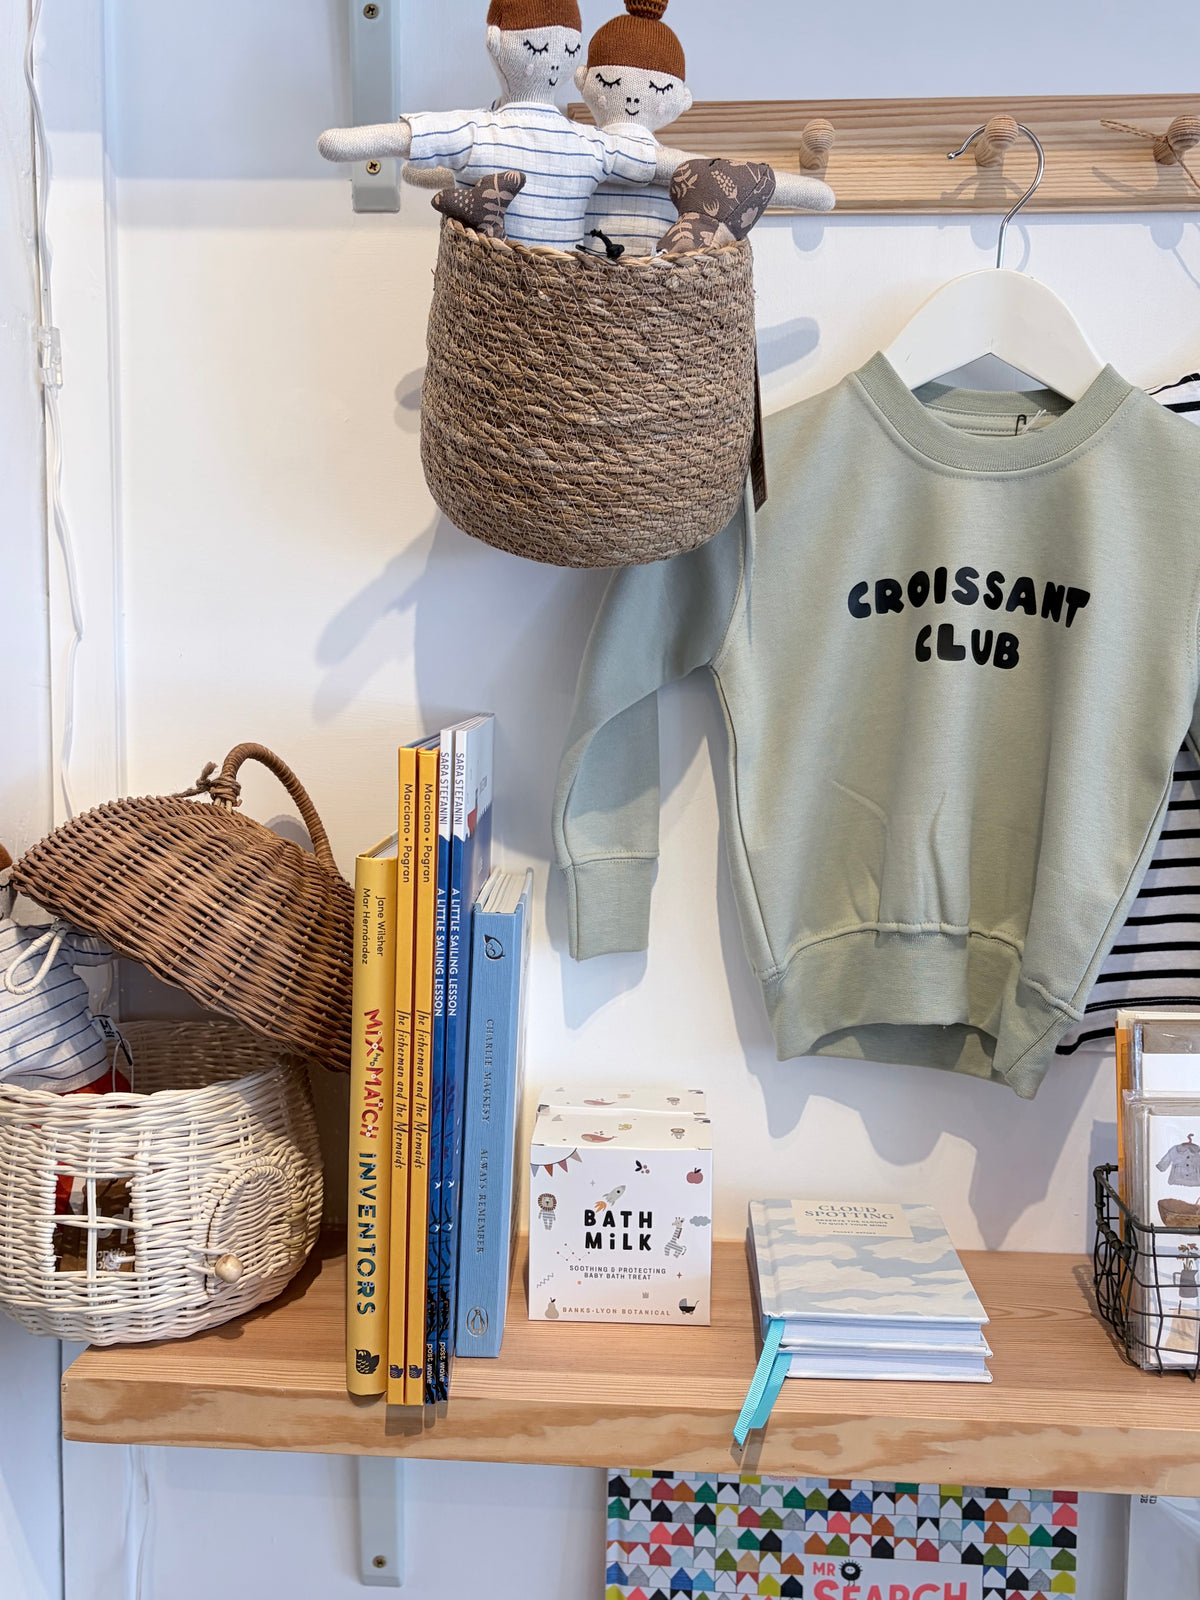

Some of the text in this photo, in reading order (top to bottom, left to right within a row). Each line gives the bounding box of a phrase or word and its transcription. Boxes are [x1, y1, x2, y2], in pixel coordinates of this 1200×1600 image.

[848, 566, 1091, 628] CROISSANT
[915, 623, 1020, 670] CLUB
[439, 752, 450, 825] SARA STEFANINI
[454, 752, 465, 825] SARA STEFANINI
[400, 783, 413, 883] Marciano Pogran
[421, 783, 433, 883] Marciano Pogran
[361, 888, 371, 965] Mar Hernández
[375, 896, 386, 956] Jane Wilsher
[434, 887, 446, 1016] A LITTLE SAILING LESSON
[448, 887, 460, 1016] A LITTLE SAILING LESSON
[396, 1009, 410, 1026] The
[416, 1009, 430, 1026] The
[359, 1067, 384, 1139] MATCH
[395, 1081, 408, 1100] and
[396, 1102, 407, 1118] the
[415, 1081, 428, 1100] and
[415, 1102, 427, 1118] the
[394, 1120, 408, 1169] Mermaids
[413, 1120, 428, 1169] Mermaids
[476, 1018, 494, 1254] CHARLIE MACKESY ALWAYS REMEMBER
[584, 1209, 653, 1229] BATH
[804, 1210, 895, 1220] SPOTTING
[818, 1205, 878, 1213] CLOUD
[569, 1265, 608, 1273] SOOTHING
[618, 1267, 667, 1275] PROTECTING
[622, 1308, 671, 1316] BOTANICAL
[426, 1343, 434, 1362] post
[812, 1561, 836, 1577] MR
